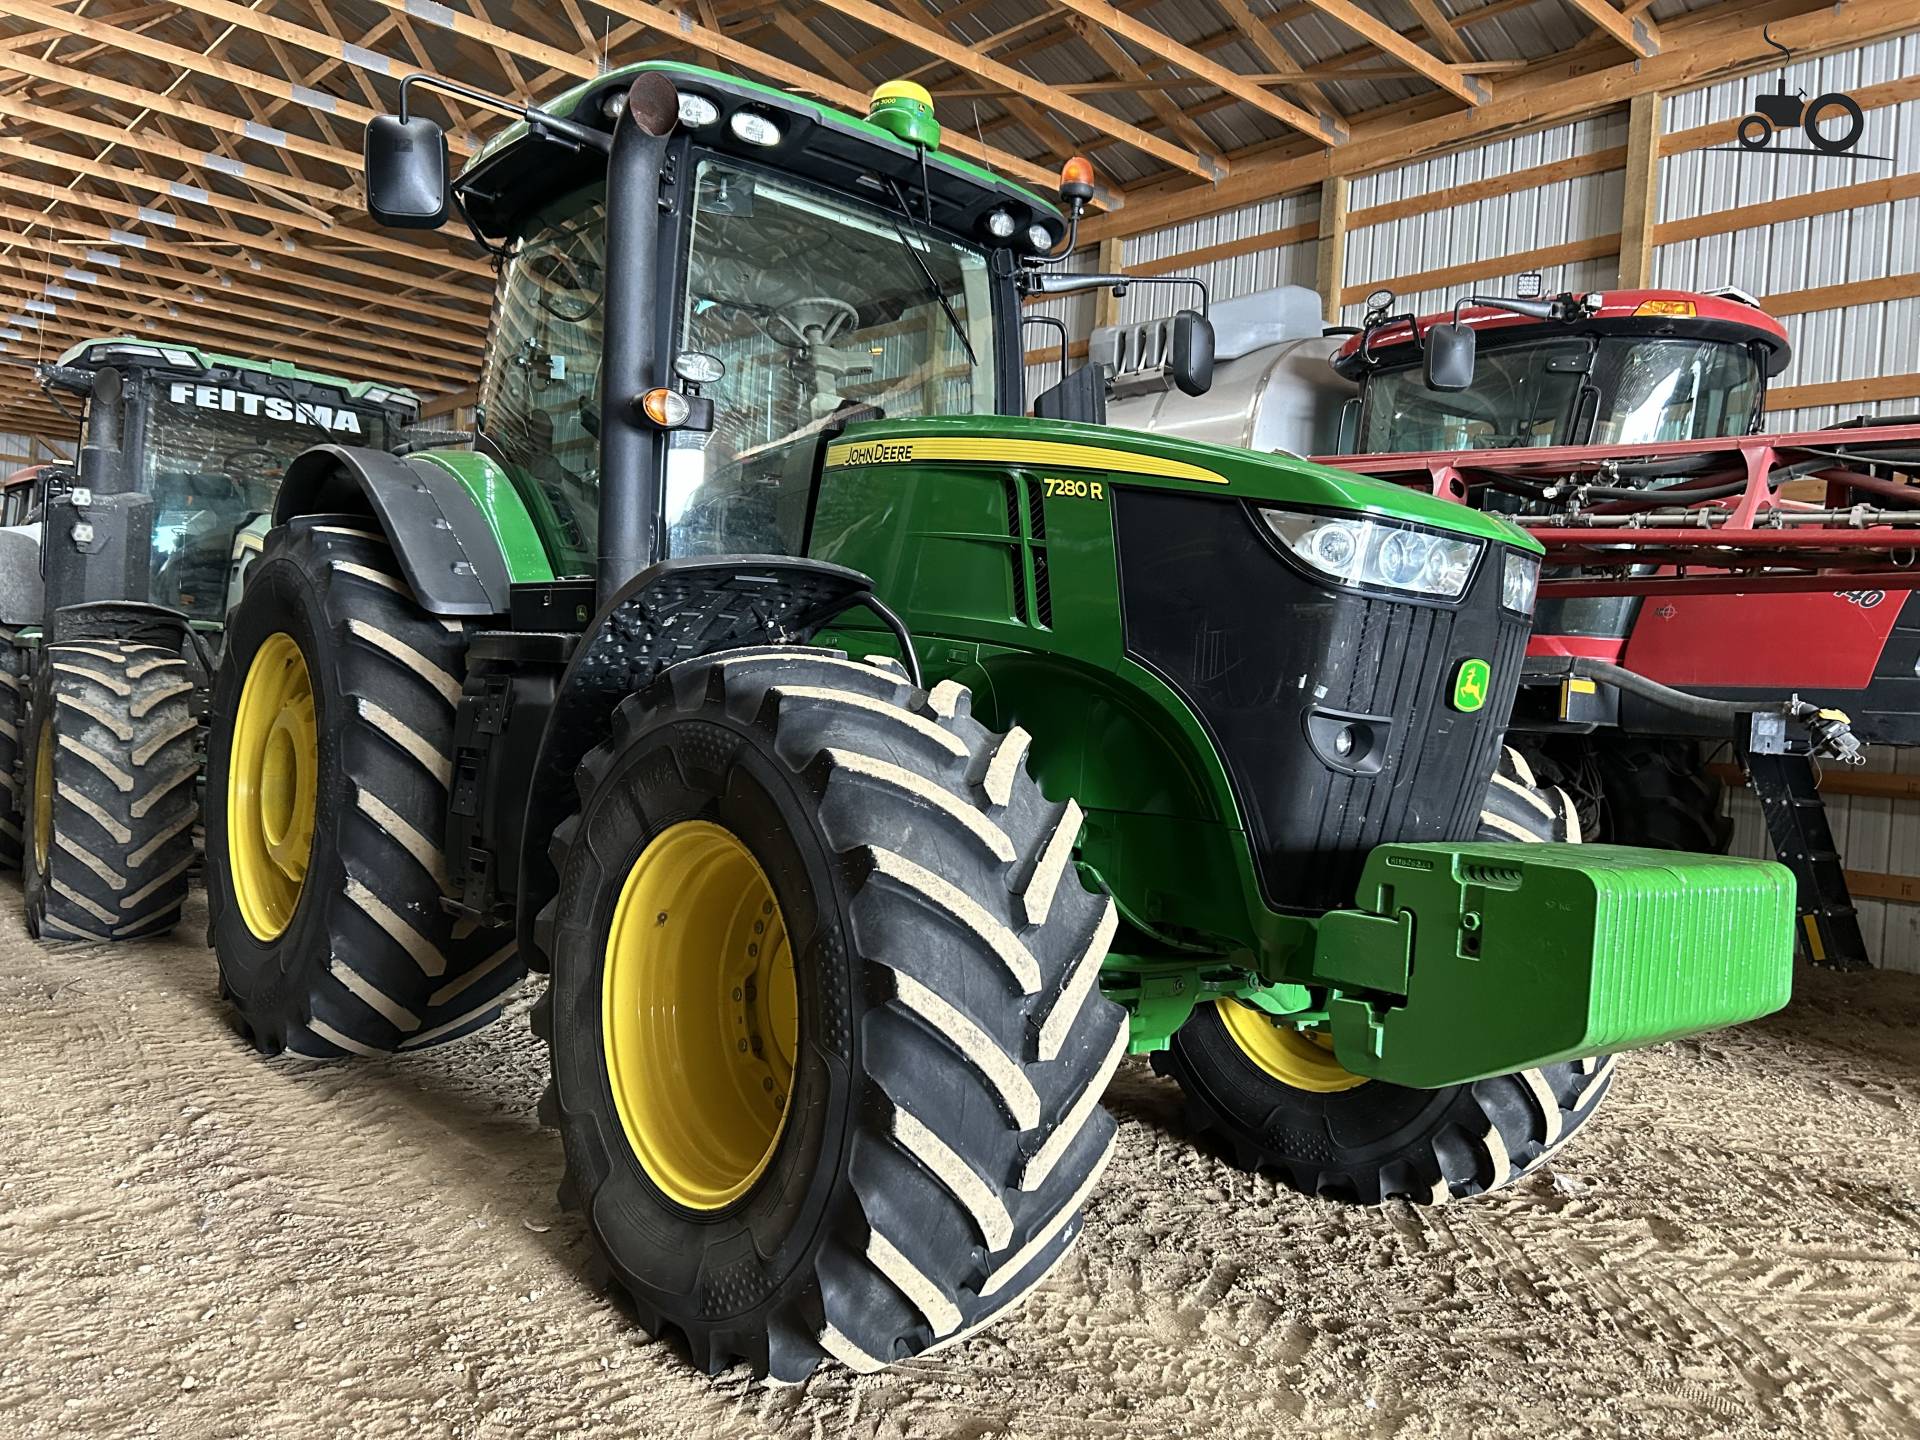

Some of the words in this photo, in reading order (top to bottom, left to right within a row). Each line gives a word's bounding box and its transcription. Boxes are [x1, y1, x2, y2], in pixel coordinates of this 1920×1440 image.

[170, 382, 362, 434] FEITSMA
[844, 447, 874, 464] JOHN
[874, 443, 914, 462] DEERE
[1043, 477, 1088, 498] 7280
[1089, 481, 1104, 500] R
